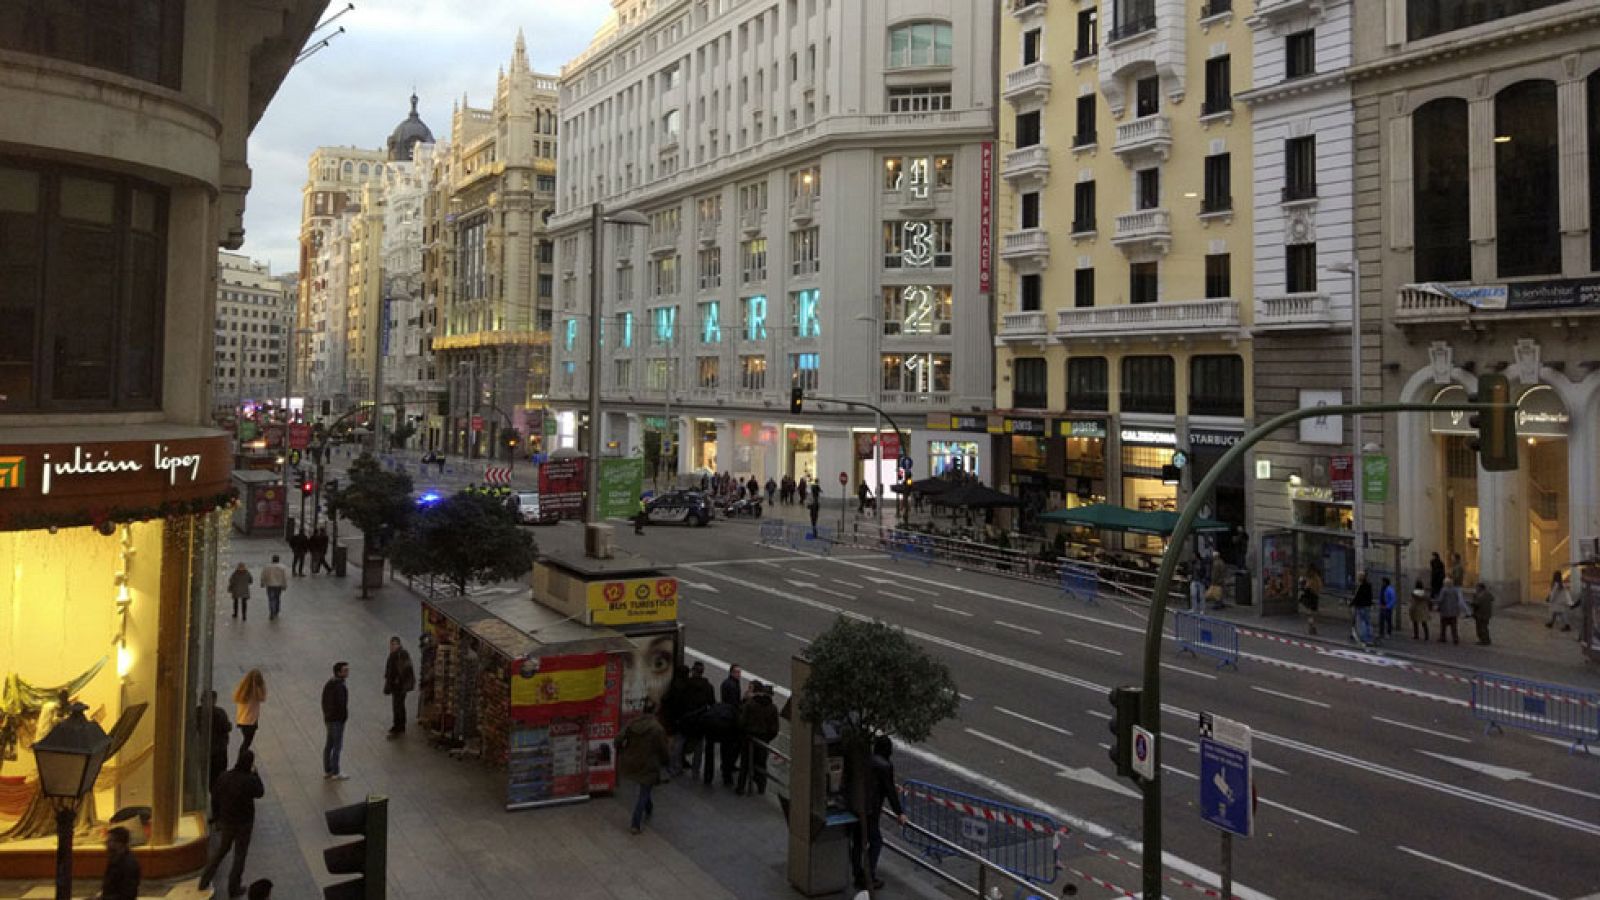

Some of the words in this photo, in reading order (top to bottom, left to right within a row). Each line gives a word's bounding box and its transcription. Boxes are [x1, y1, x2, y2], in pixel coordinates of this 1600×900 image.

[982, 149, 991, 199] PETIT
[903, 220, 933, 266] 3
[981, 208, 990, 269] PALACE
[565, 288, 821, 352] PIMARK
[903, 285, 933, 333] 2
[1189, 433, 1243, 447] STARBUCK
[41, 445, 143, 495] julián
[153, 443, 202, 486] lópez
